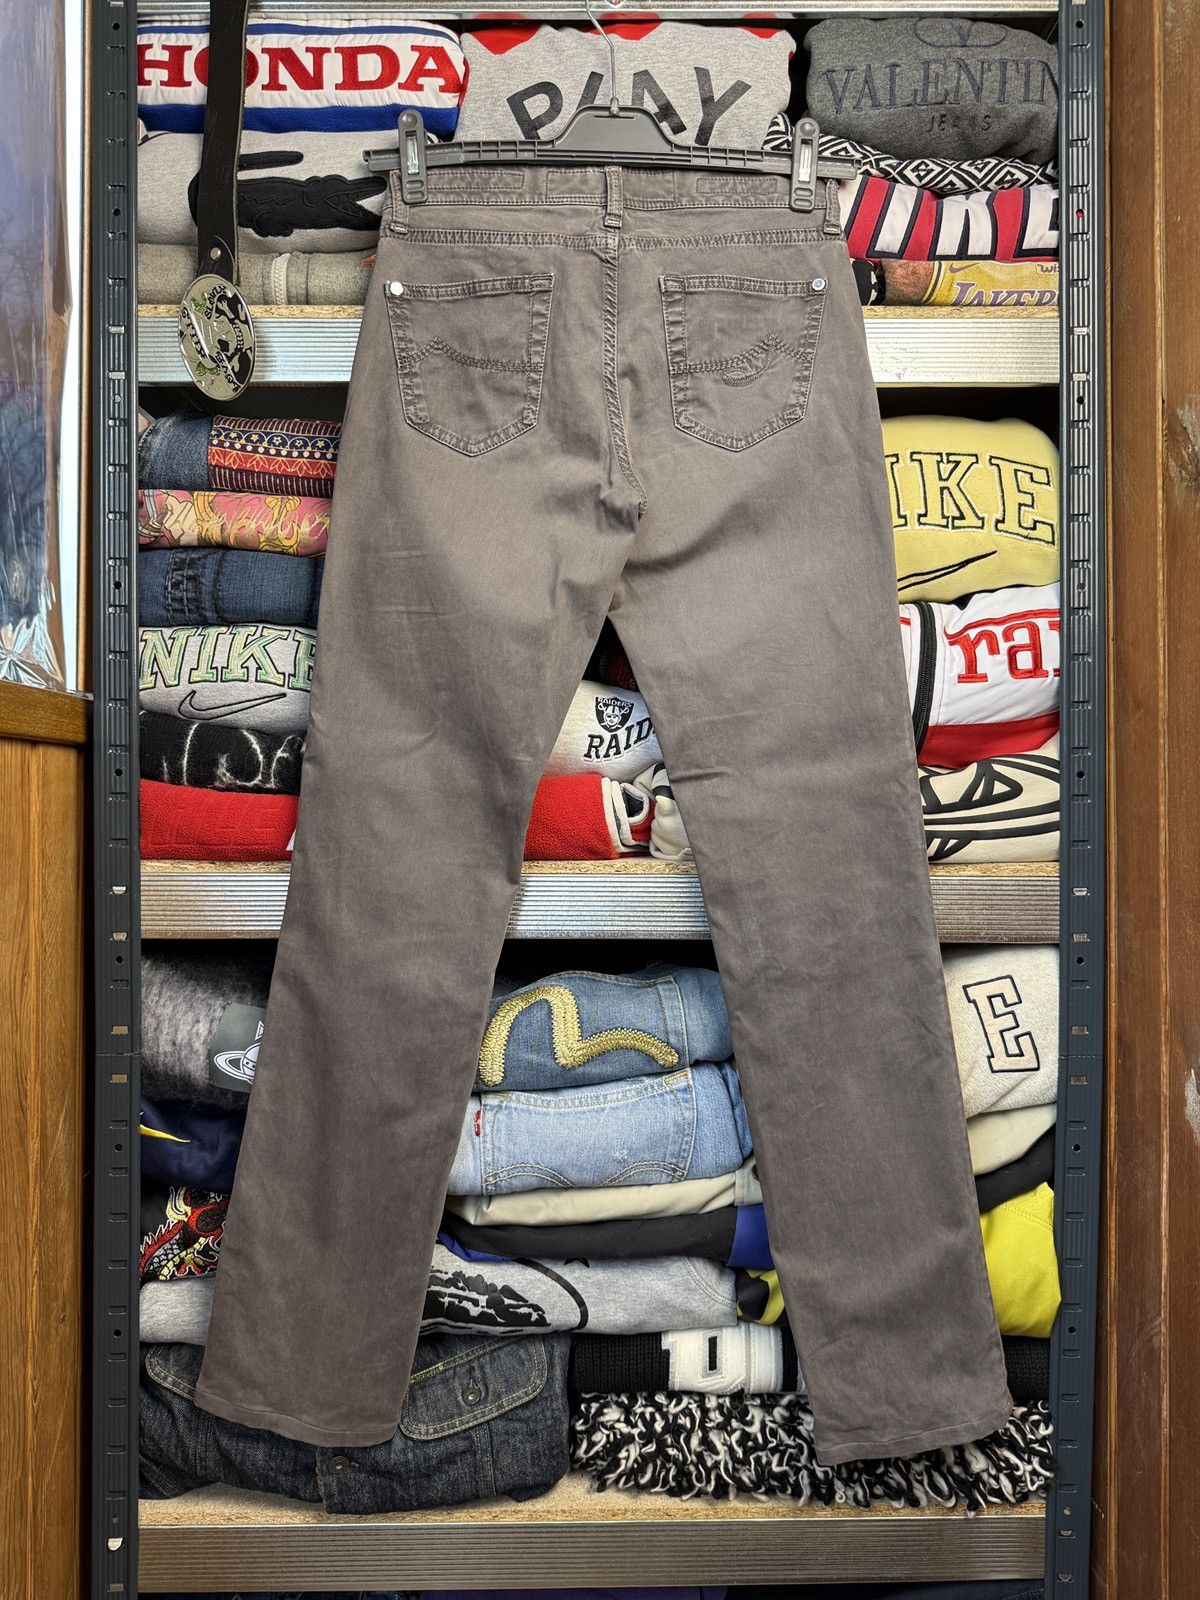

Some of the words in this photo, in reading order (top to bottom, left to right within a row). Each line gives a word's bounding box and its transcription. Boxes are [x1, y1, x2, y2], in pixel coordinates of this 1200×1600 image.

[926, 114, 992, 132] JES
[948, 619, 1060, 684] ra
[583, 717, 656, 760] RAID
[962, 974, 1040, 1073] E
